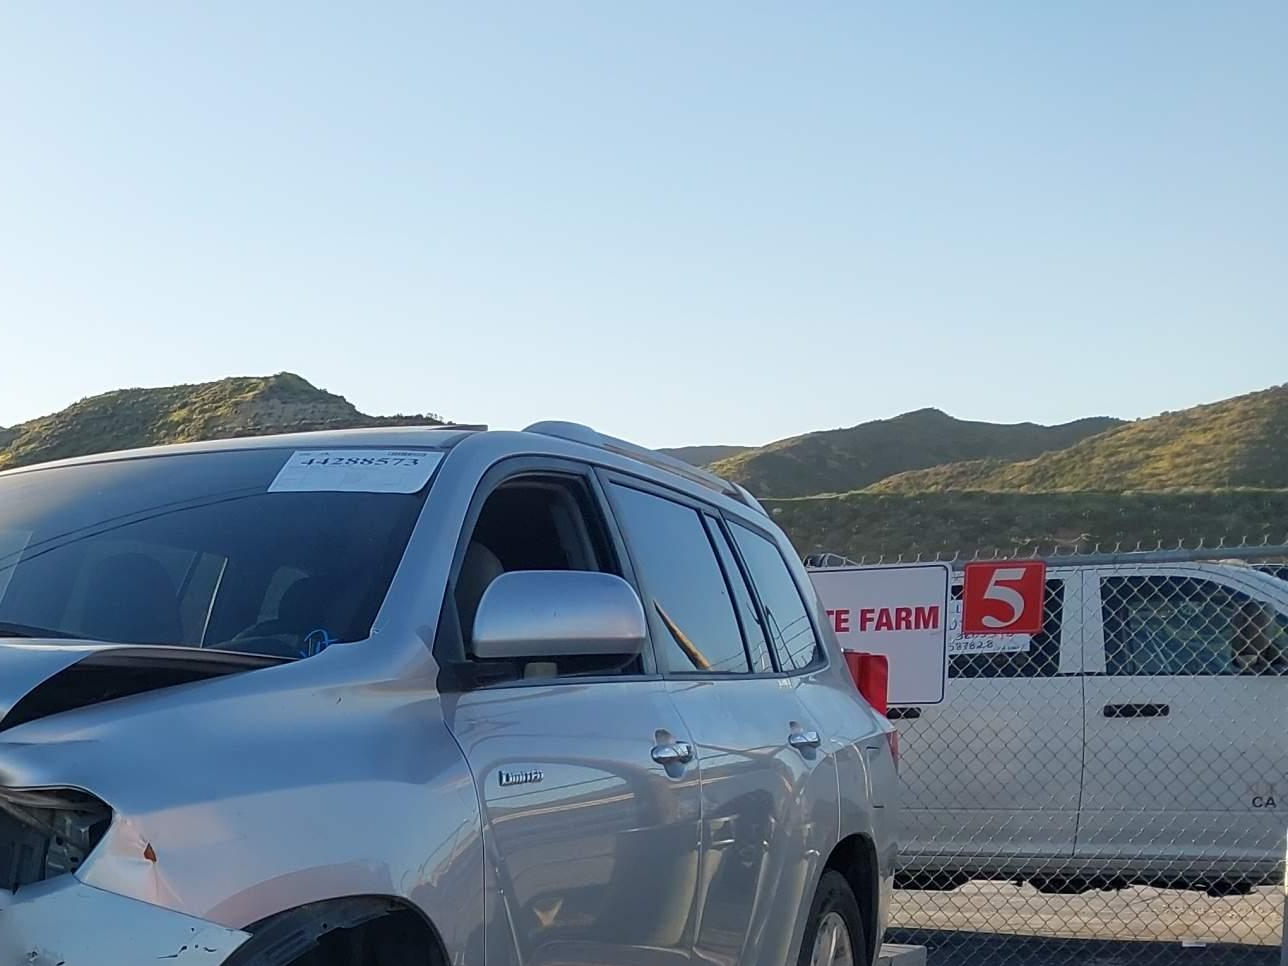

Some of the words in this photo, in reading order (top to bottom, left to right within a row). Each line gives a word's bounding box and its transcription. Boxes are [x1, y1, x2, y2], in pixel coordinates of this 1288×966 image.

[301, 457, 419, 466] 44288573
[981, 568, 1027, 628] 5
[860, 606, 939, 632] FARM
[1252, 796, 1277, 808] CA
